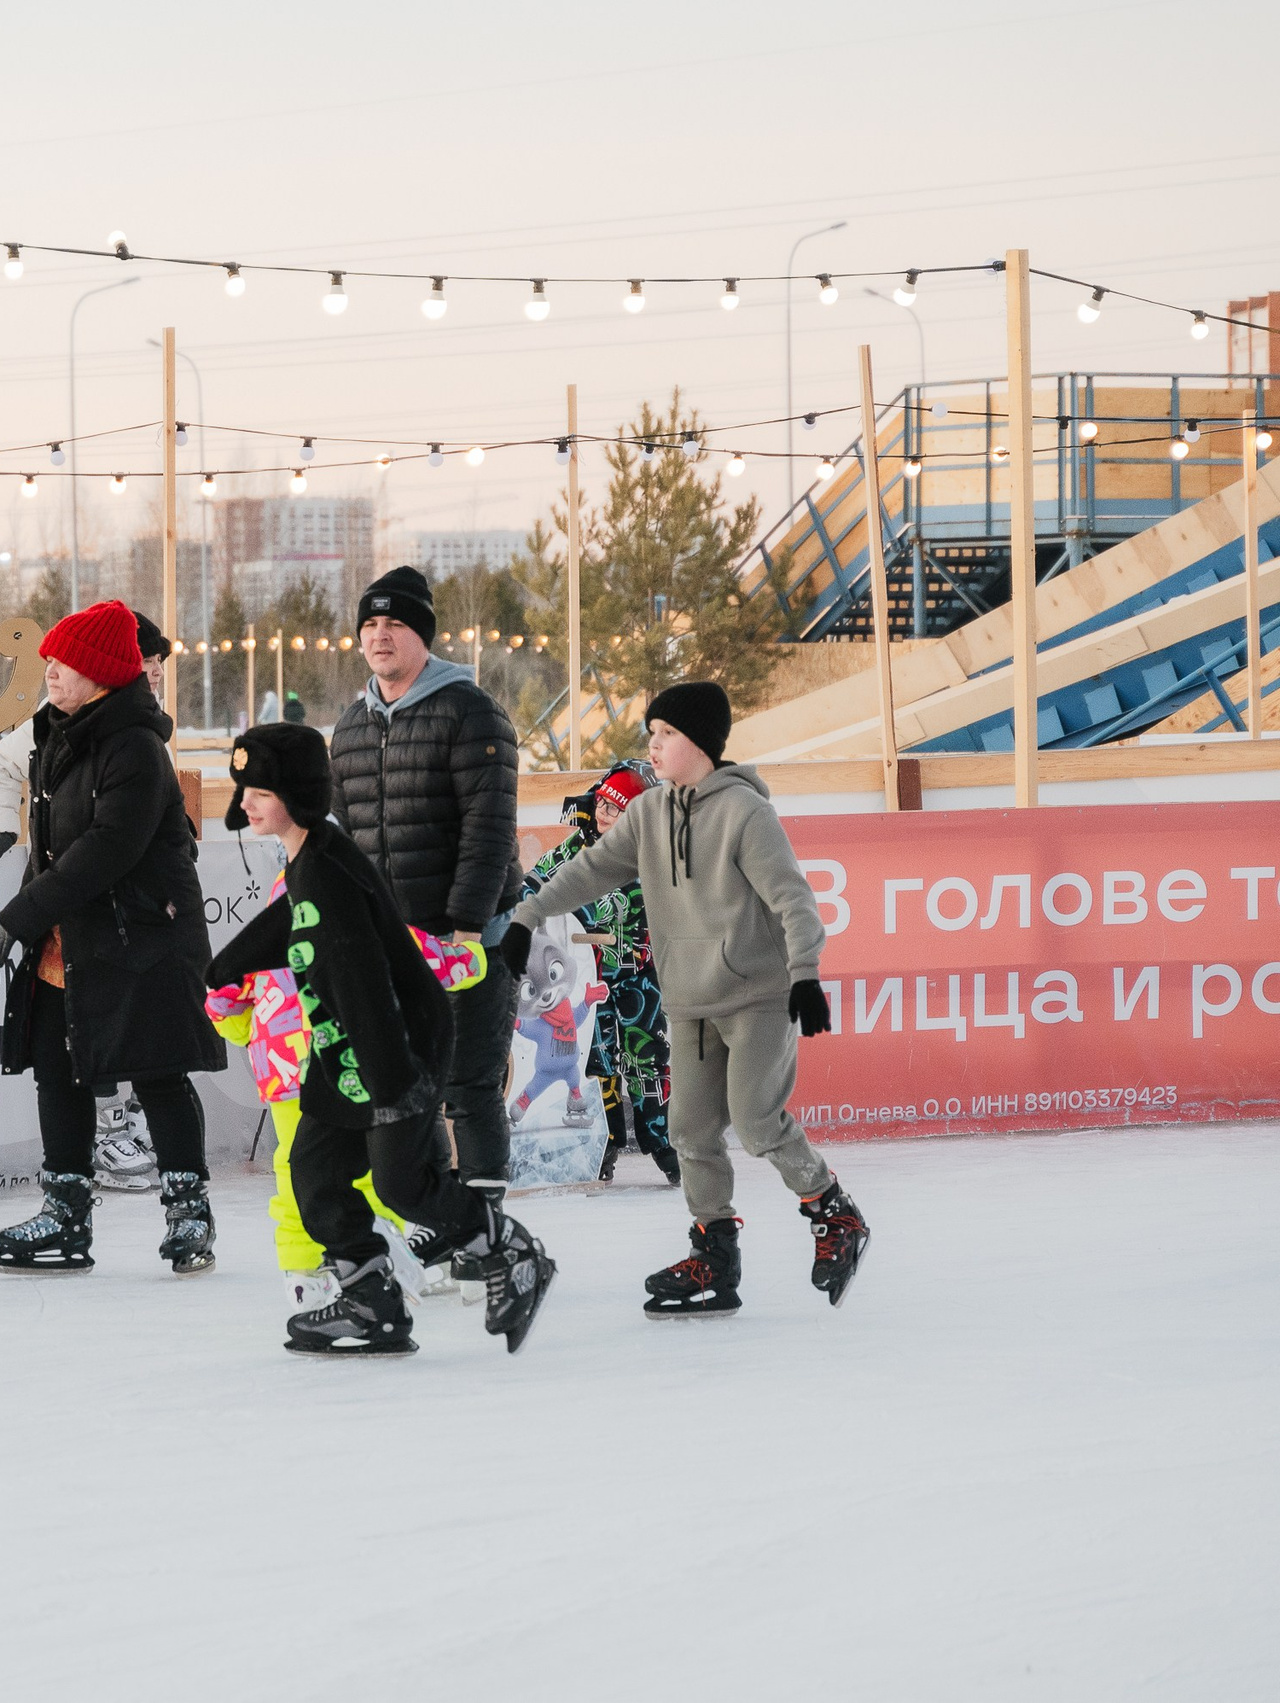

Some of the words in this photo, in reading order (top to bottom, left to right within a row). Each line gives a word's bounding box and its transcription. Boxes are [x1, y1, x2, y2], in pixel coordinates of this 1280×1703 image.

[606, 786, 628, 806] PATH
[797, 859, 851, 937] В
[884, 868, 1208, 932] голове
[1230, 866, 1280, 920] т
[1113, 966, 1160, 1021] и
[801, 1105, 832, 1125] ИП
[838, 1103, 917, 1123] Огнева
[971, 1095, 1019, 1114] ИНН
[1024, 1086, 1178, 1112] 891103379423
